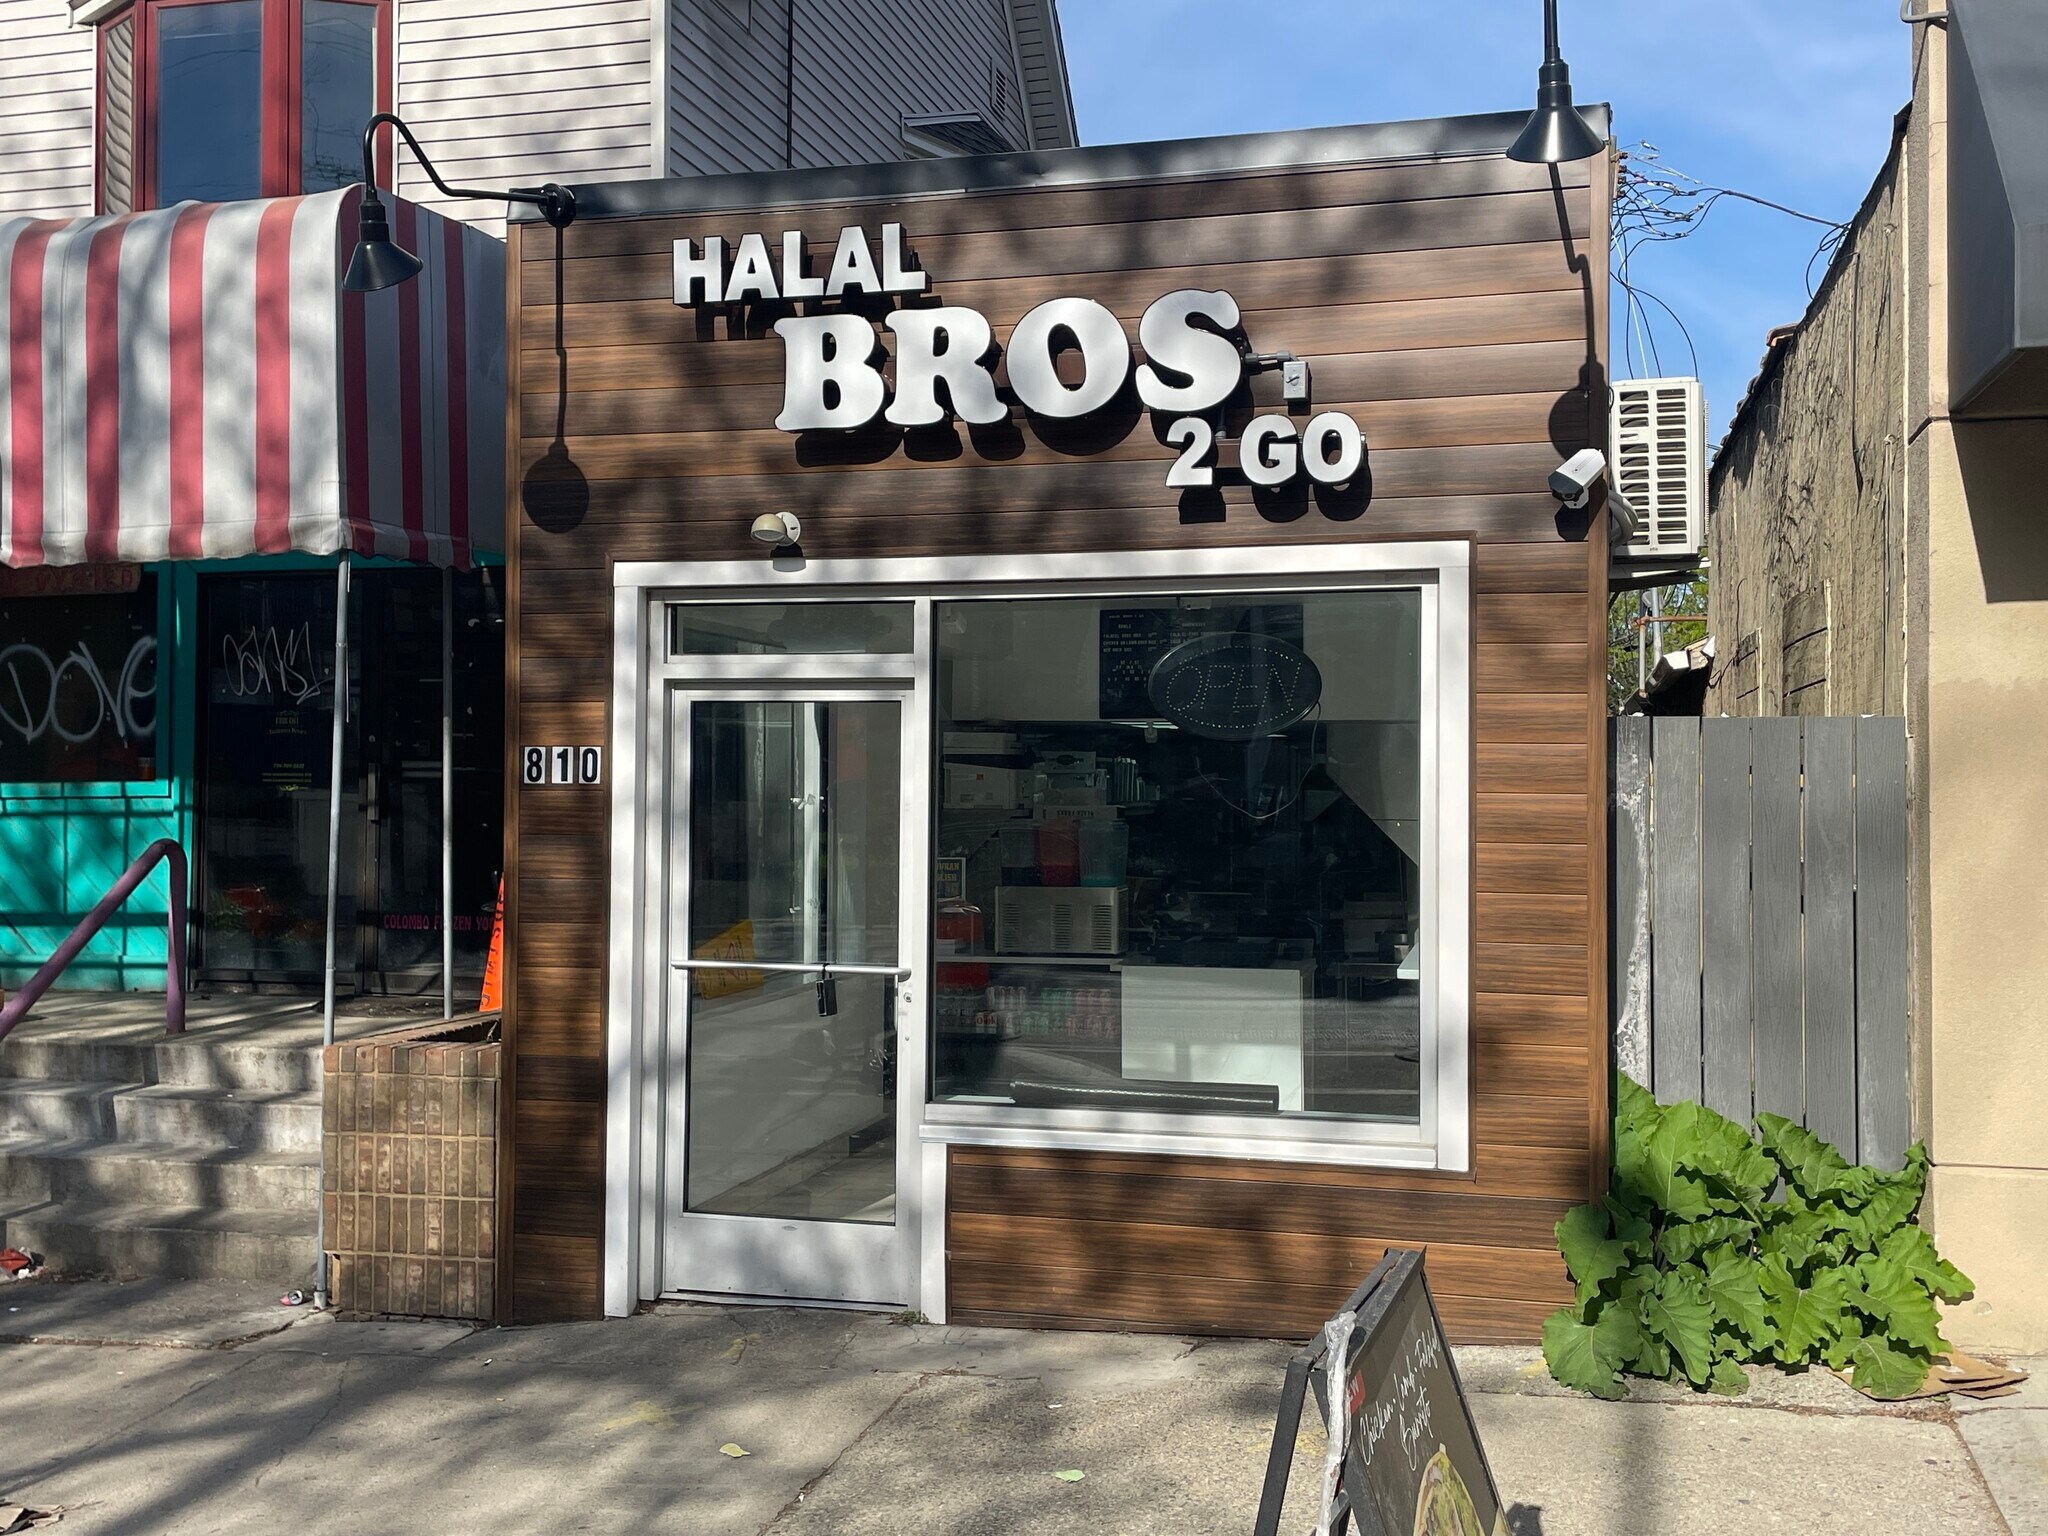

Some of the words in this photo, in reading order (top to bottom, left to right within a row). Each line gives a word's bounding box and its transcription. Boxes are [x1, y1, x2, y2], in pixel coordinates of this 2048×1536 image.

[672, 222, 928, 305] HALAL
[774, 289, 1243, 431] BROS
[1166, 416, 1215, 488] 2
[1238, 411, 1364, 487] GO
[1165, 662, 1301, 711] OPEN
[526, 748, 598, 783] 810
[383, 914, 429, 931] COLOMBO
[433, 914, 471, 932] FZEN
